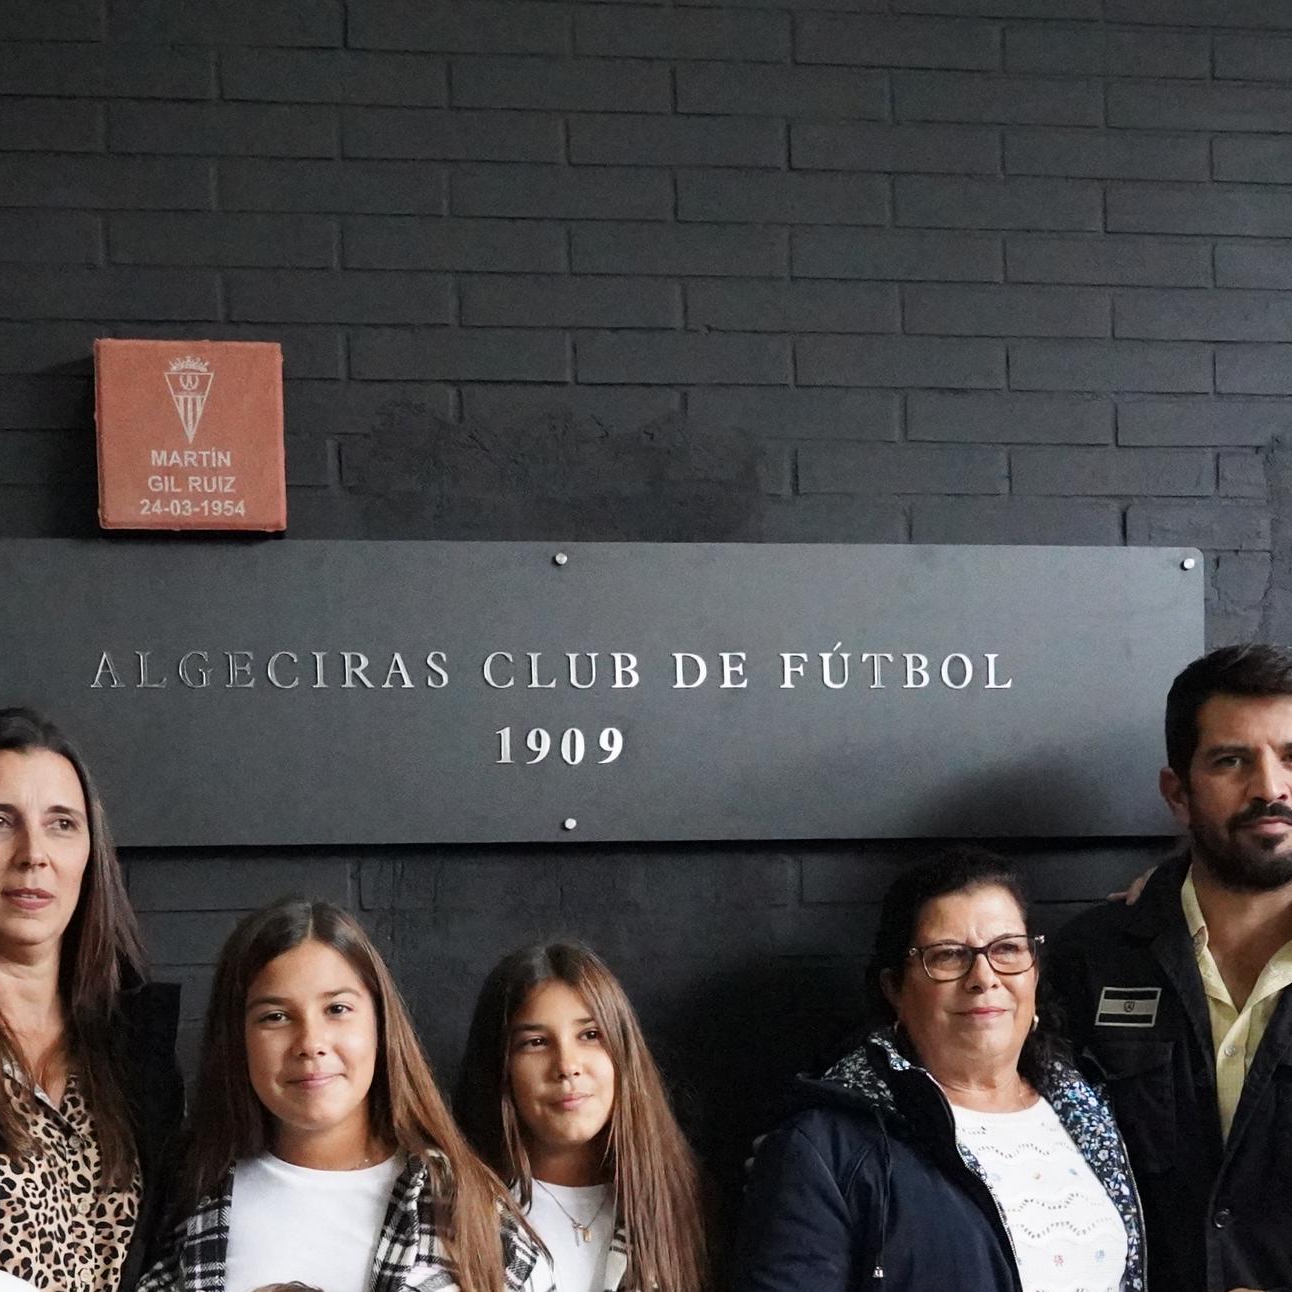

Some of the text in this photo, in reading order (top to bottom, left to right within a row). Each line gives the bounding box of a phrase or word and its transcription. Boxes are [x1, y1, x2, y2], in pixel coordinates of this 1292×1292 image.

[150, 446, 231, 468] MARTÍN
[147, 475, 236, 494] GIL RUIZ
[139, 498, 246, 517] 24-03-1954
[90, 641, 1014, 690] ALGECIRAS CLUB DE FÚTBOL
[495, 726, 624, 766] 1909
